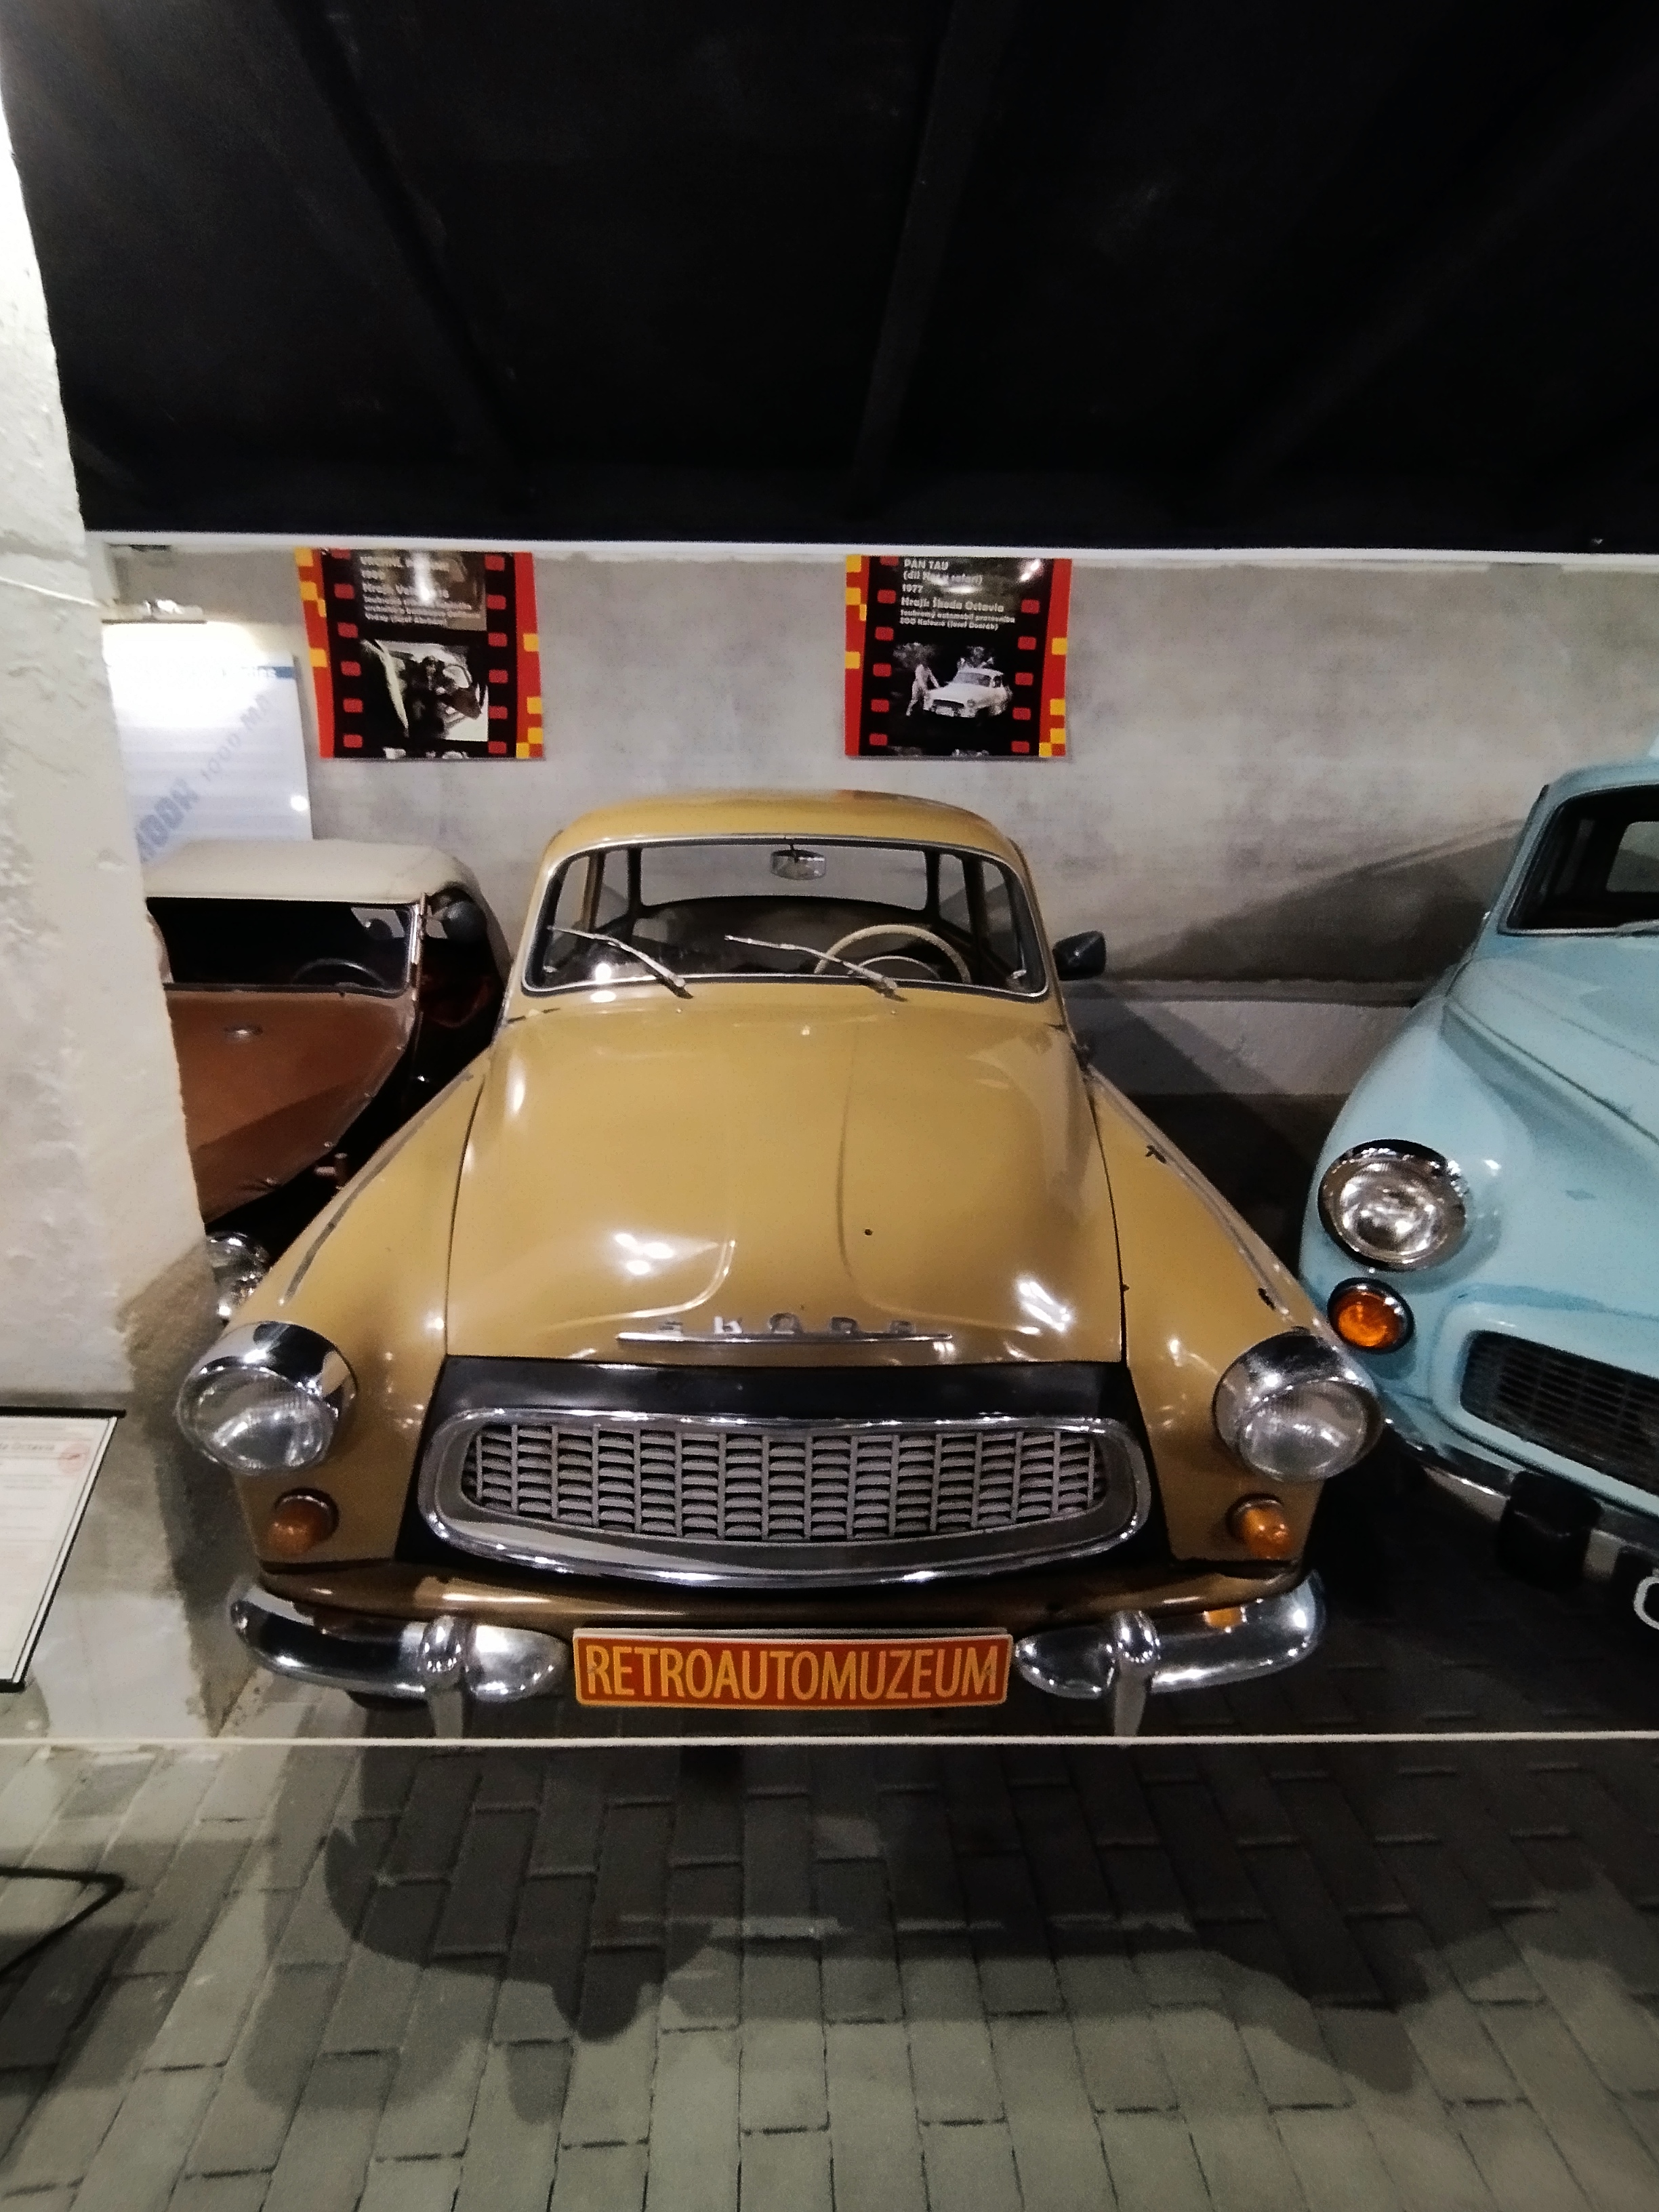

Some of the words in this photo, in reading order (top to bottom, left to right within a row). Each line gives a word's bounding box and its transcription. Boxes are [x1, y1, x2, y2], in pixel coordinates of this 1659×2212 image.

[904, 558, 926, 569] PAN
[929, 560, 949, 571] TAU
[965, 600, 1004, 613] Octavia
[585, 1643, 998, 1701] RETROAUTOMUZEUM
